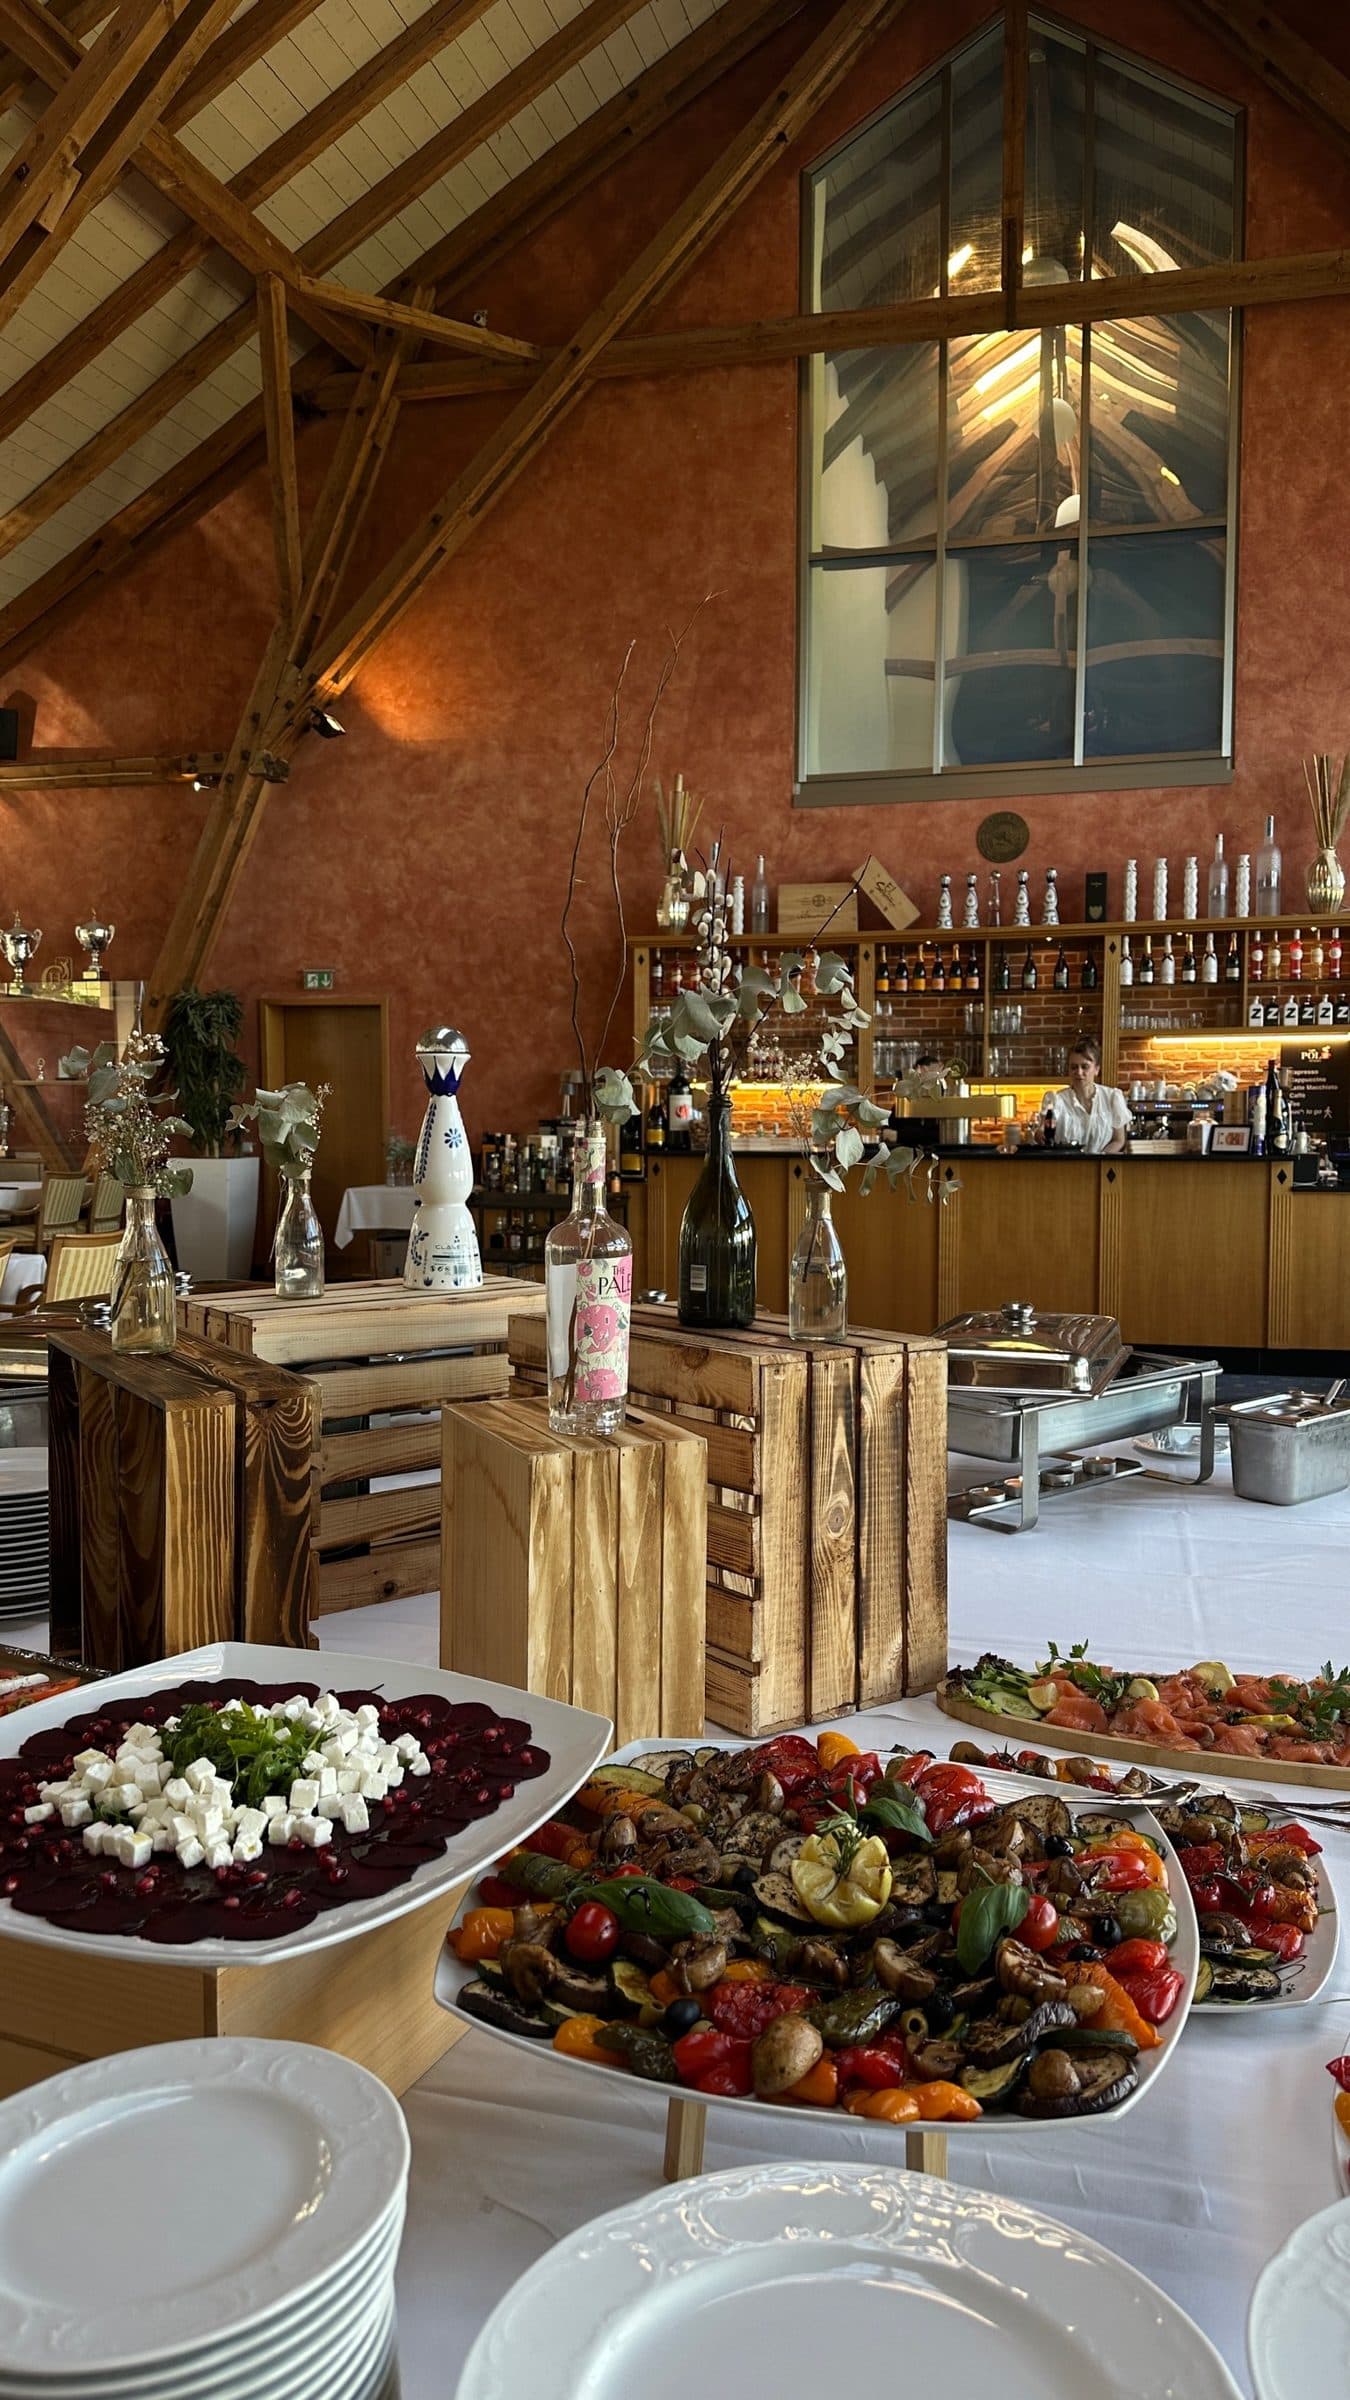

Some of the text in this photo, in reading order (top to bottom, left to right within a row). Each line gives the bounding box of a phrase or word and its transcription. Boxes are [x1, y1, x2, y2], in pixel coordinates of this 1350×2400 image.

[1251, 1007, 1262, 1019] Z
[1267, 1007, 1279, 1019] Z
[1286, 1007, 1297, 1019] Z
[1302, 1006, 1314, 1019] Z
[1320, 1007, 1331, 1018] Z
[1337, 1006, 1349, 1018] Z
[612, 1265, 625, 1276] THE
[598, 1273, 632, 1296] PALE
